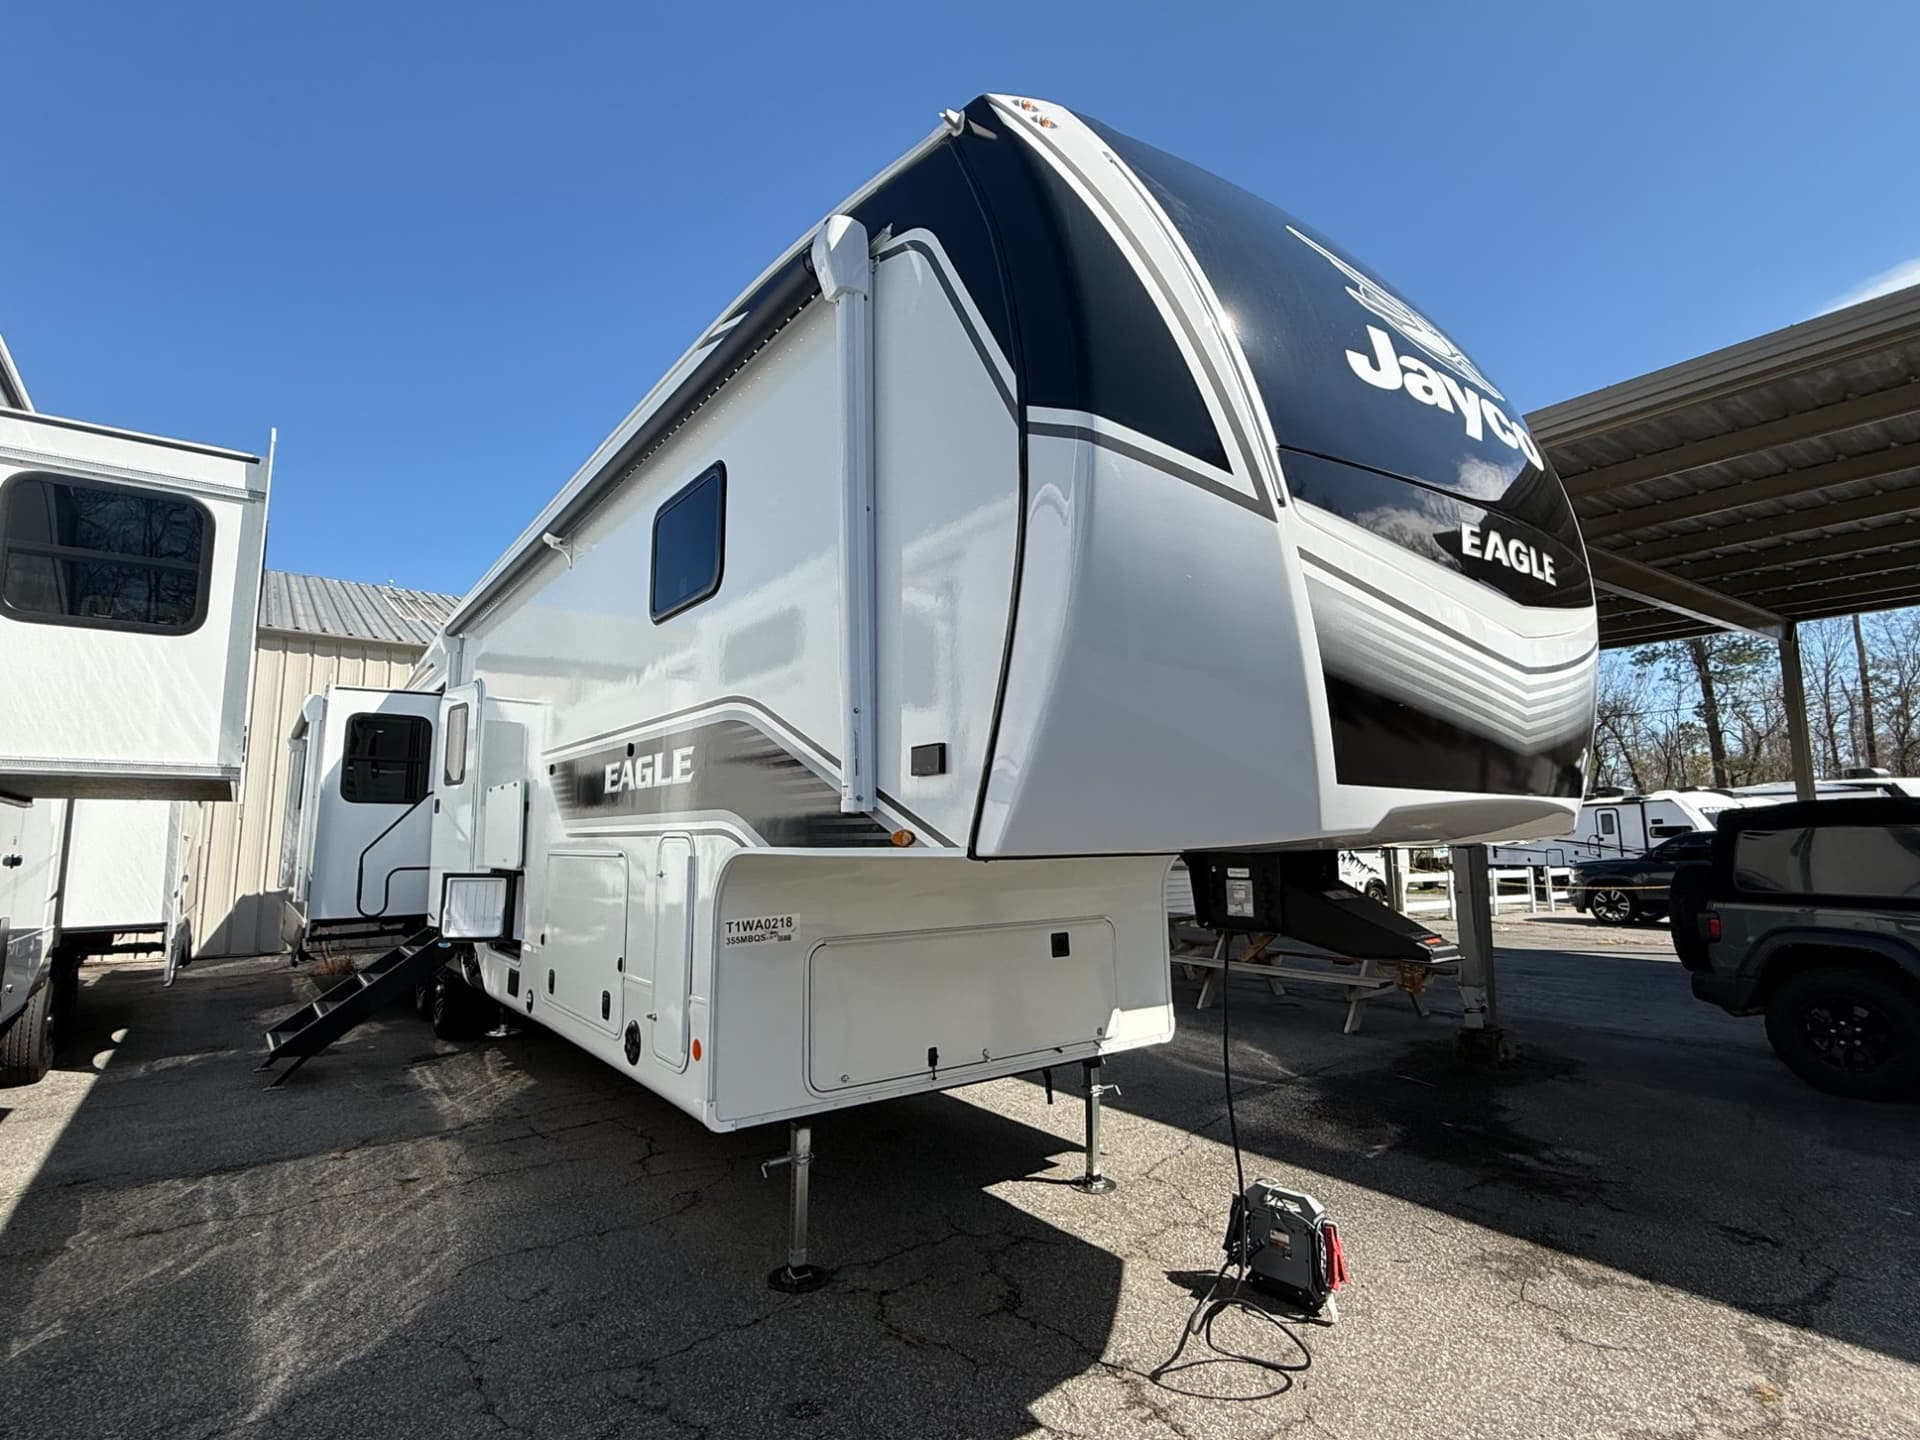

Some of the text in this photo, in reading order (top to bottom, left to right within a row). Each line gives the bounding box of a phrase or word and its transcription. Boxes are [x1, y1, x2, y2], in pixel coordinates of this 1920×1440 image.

[1345, 325, 1545, 472] Jayco
[1461, 522, 1557, 587] EAGLE
[604, 746, 695, 794] EAGLE
[725, 916, 793, 934] T1WA0218
